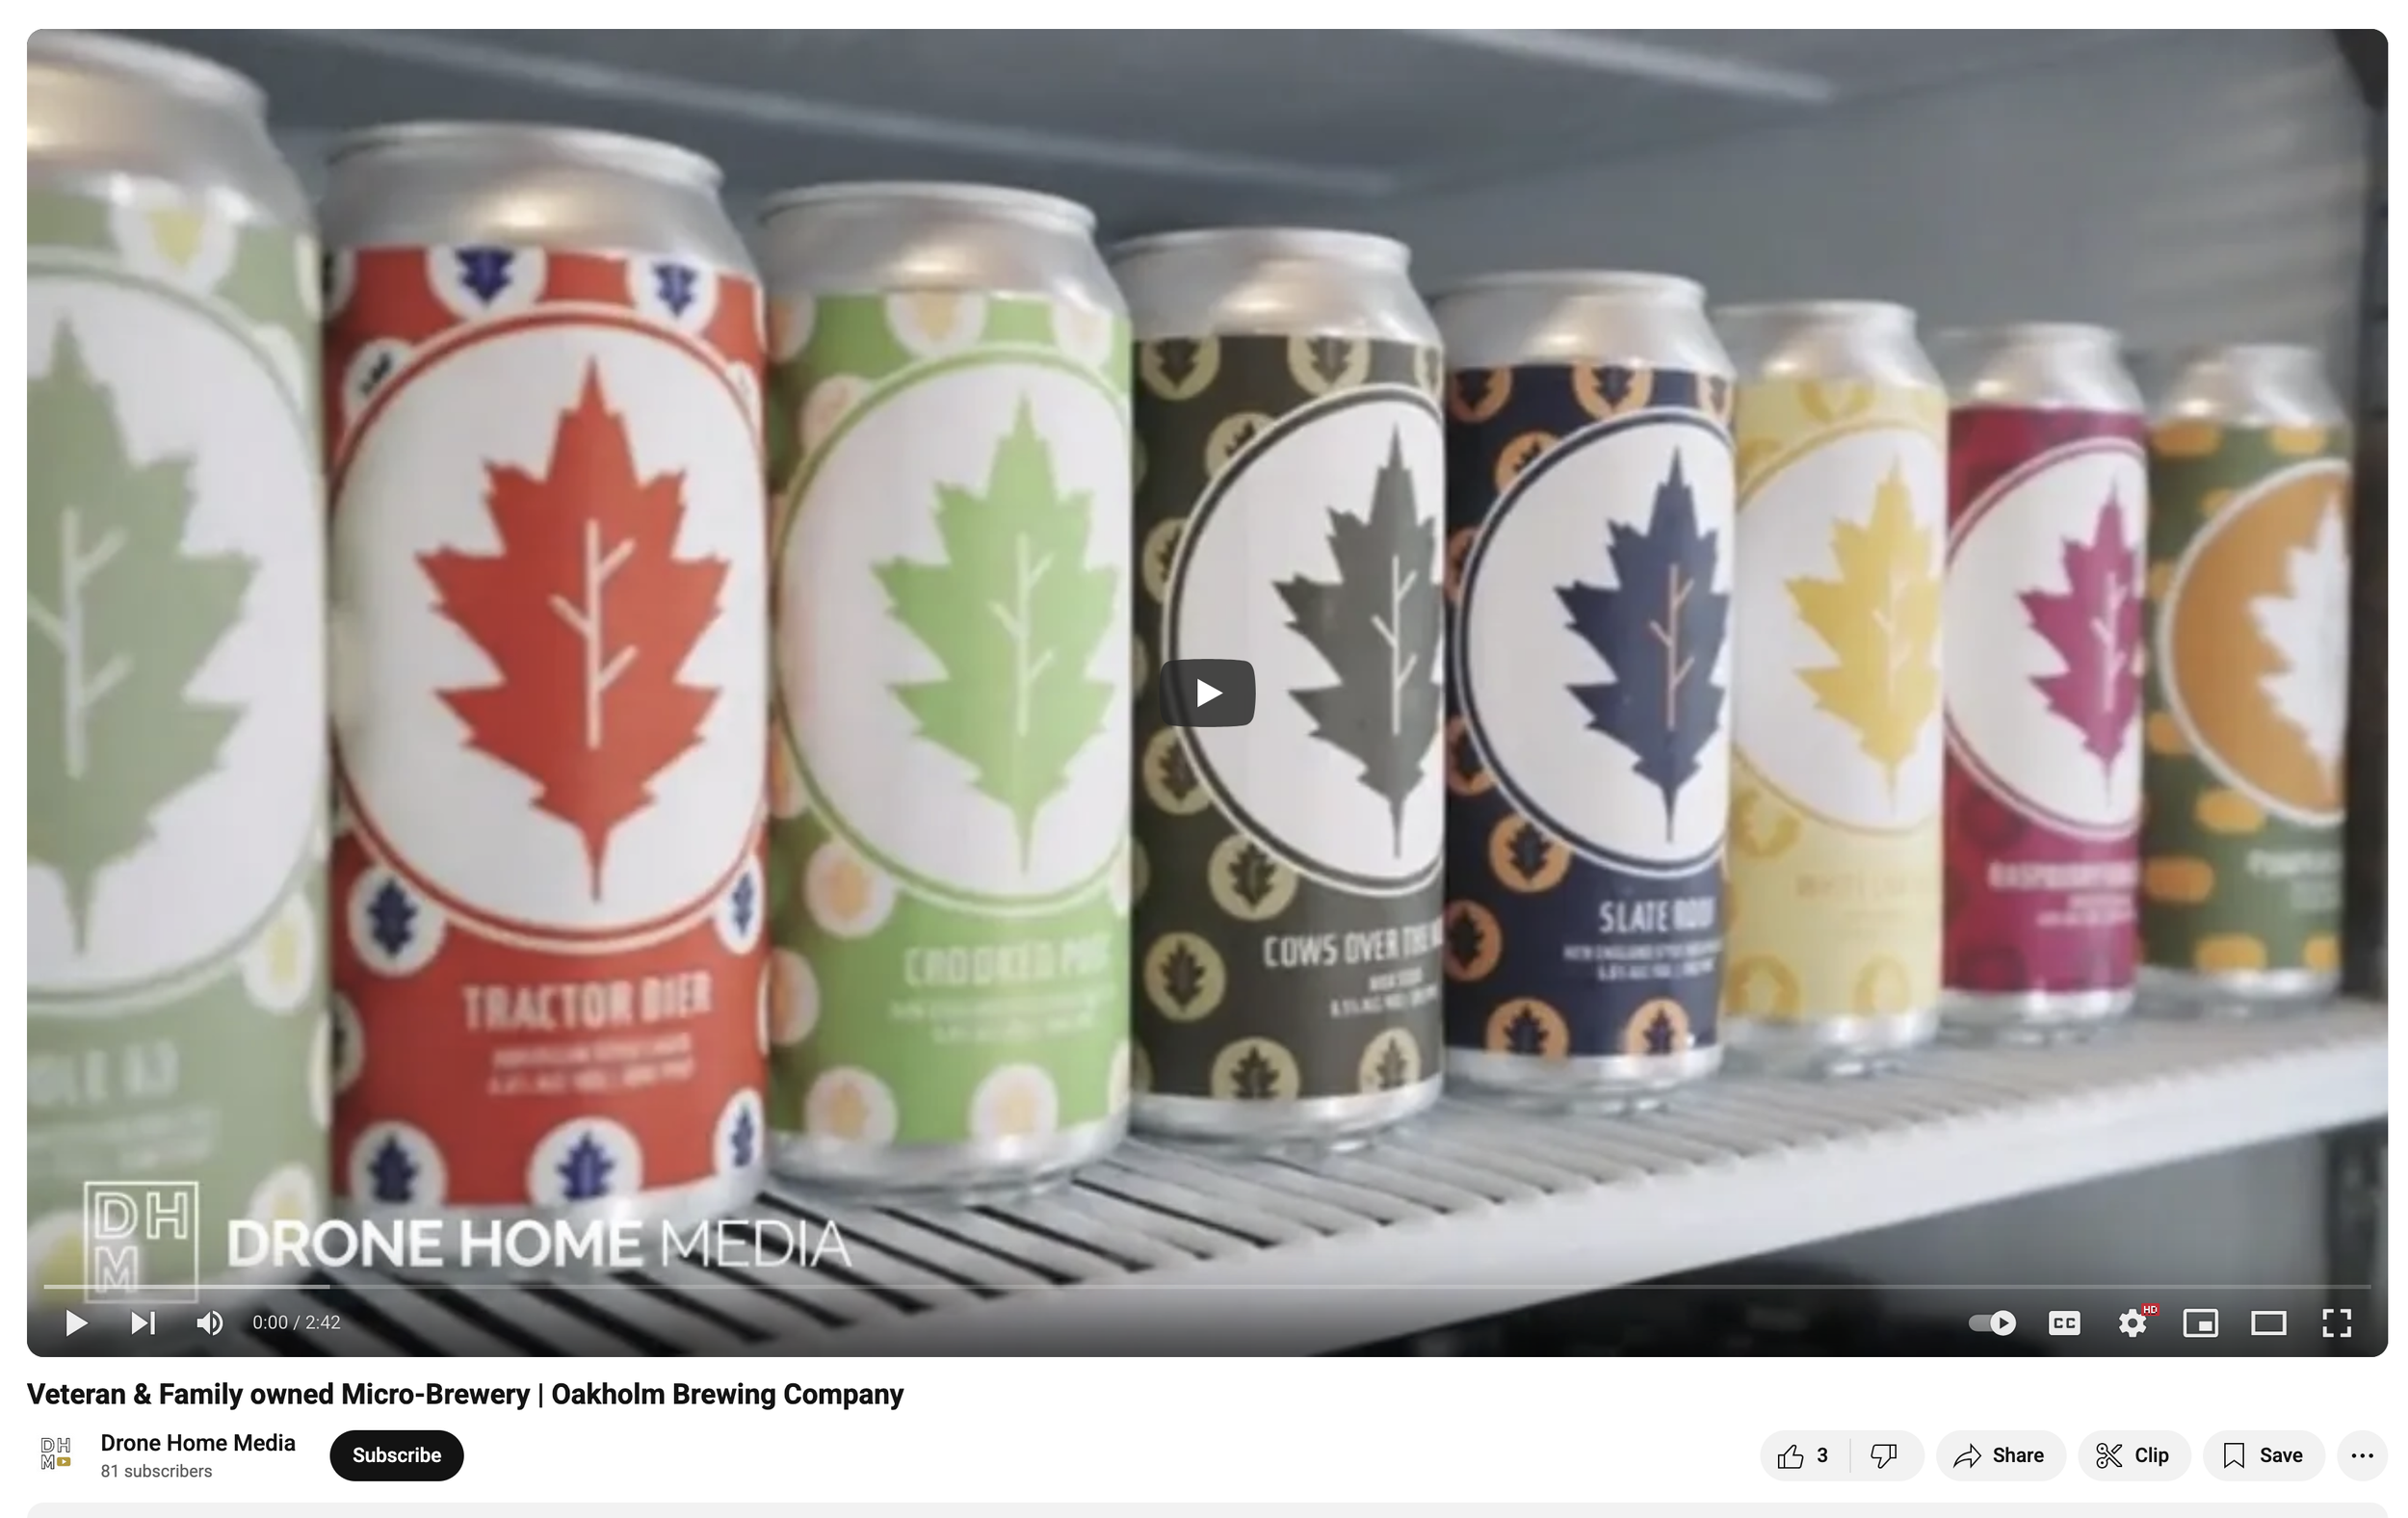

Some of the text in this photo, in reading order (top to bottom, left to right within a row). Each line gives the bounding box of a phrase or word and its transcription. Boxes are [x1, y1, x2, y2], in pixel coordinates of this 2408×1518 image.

[1599, 900, 1669, 933] SLATE
[1264, 932, 1339, 969] COWS
[1344, 928, 1400, 965] OVER
[462, 978, 633, 1033] TRACTOR
[2143, 1305, 2158, 1315] HD
[252, 1315, 288, 1330] 0:00
[305, 1315, 341, 1330] 2:42
[2054, 1317, 2076, 1329] CC
[27, 1382, 126, 1405] Veteran
[133, 1382, 152, 1405] &
[160, 1381, 244, 1411] Family
[250, 1381, 334, 1405] owned
[342, 1381, 531, 1411] Micro-Brewery
[551, 1381, 666, 1405] Oakholm
[673, 1381, 776, 1411] Brewing
[784, 1382, 905, 1411] Company
[101, 1432, 297, 1452] Drone Home Media
[353, 1446, 442, 1463] Subscribe
[1817, 1447, 1828, 1463] 3
[1993, 1446, 2045, 1463] Share
[2134, 1446, 2170, 1467] Clip
[2260, 1447, 2304, 1463] Save
[100, 1463, 213, 1479] 81 subscribers
